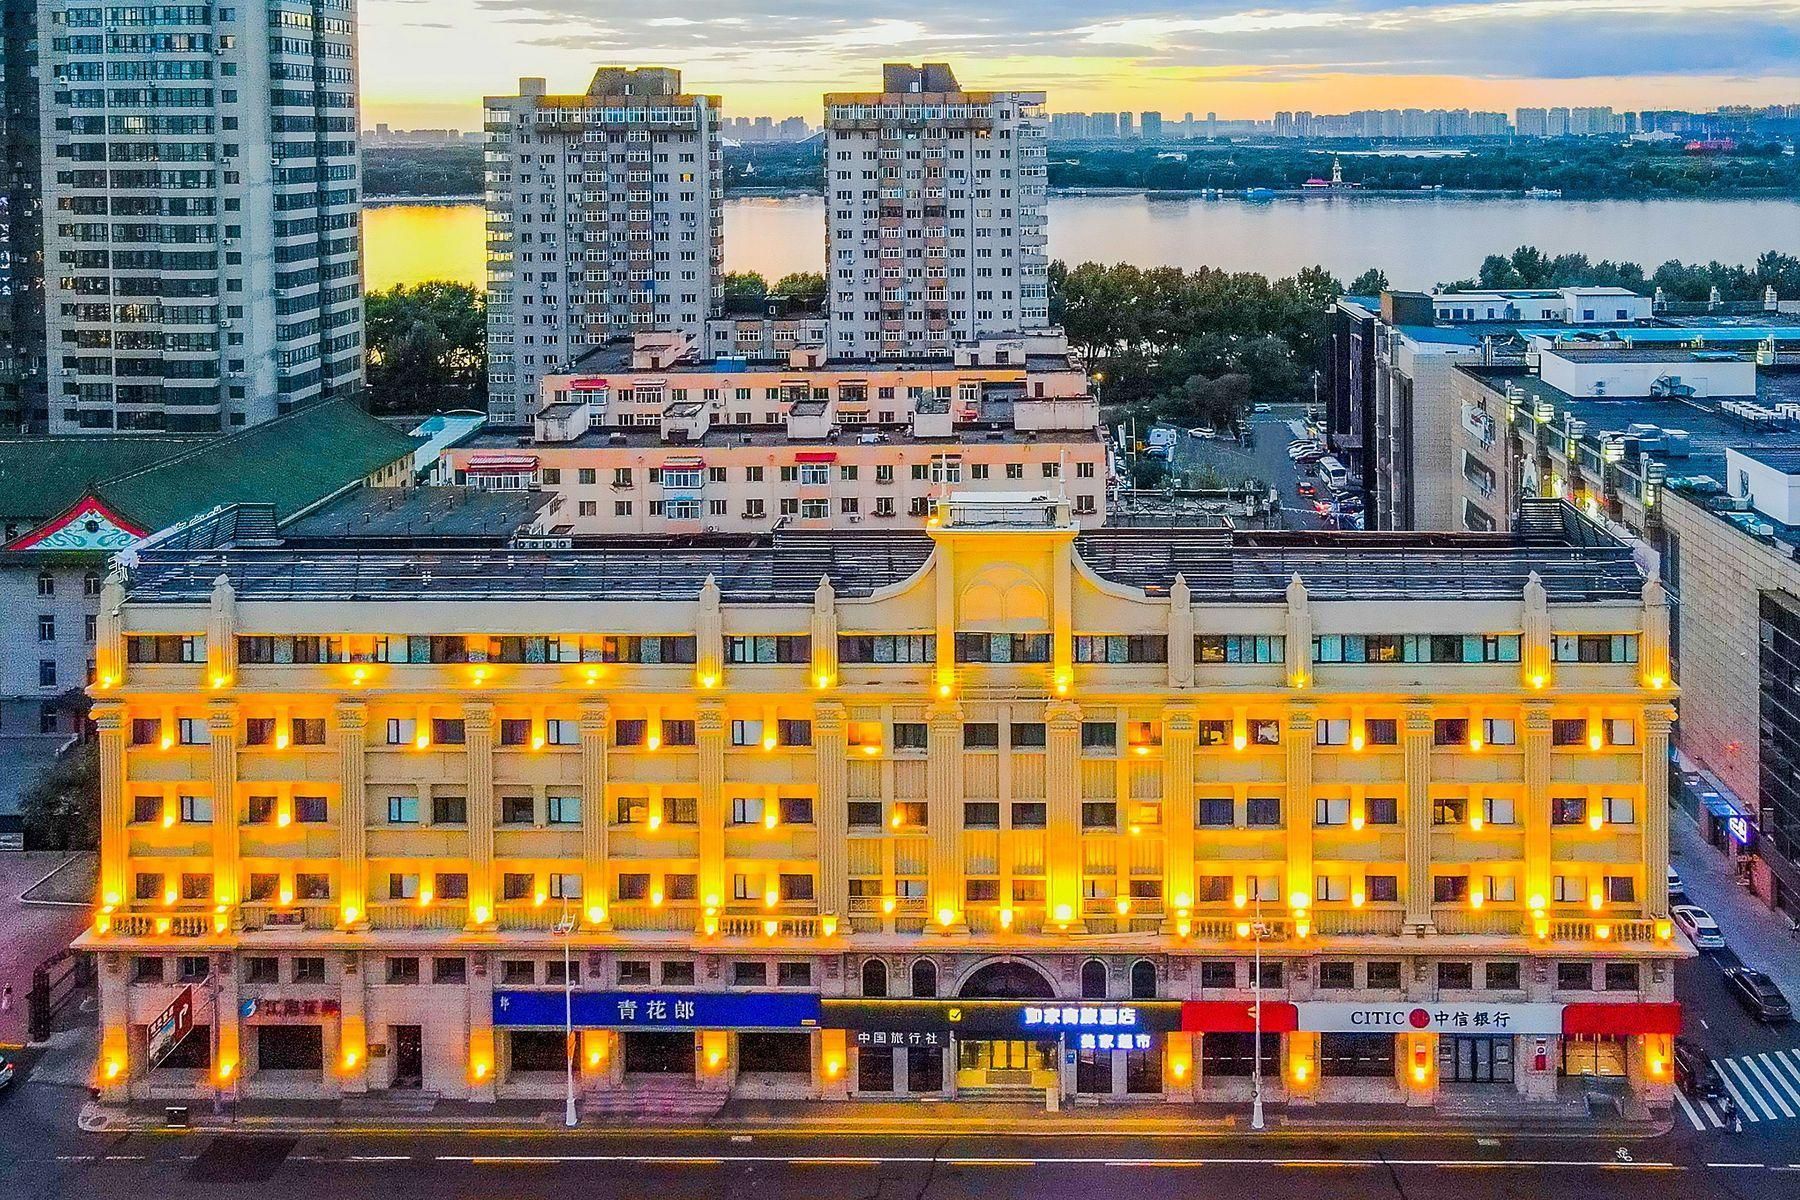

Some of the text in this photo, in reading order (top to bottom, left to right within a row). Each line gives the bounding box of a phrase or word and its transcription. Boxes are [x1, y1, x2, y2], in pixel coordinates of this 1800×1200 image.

[617, 1000, 695, 1019] 青花郎
[1351, 1010, 1511, 1027] CITIC 中信银行
[858, 1032, 938, 1044] 中国旅行社
